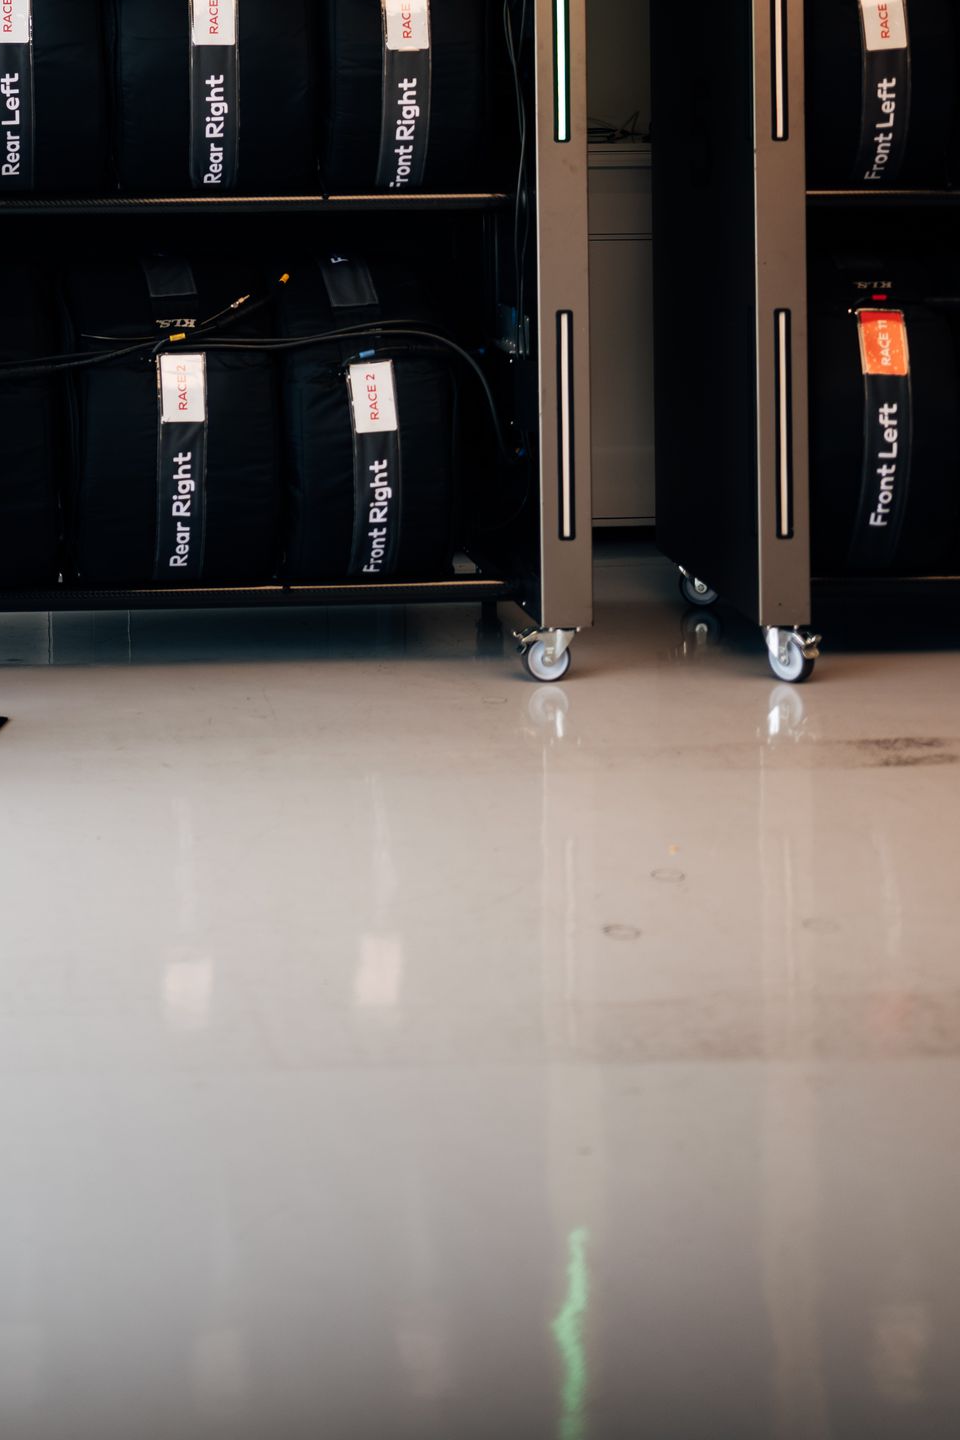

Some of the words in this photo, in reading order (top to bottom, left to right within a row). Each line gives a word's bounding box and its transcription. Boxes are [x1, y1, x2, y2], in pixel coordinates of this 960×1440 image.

[208, 3, 219, 35] RACE
[401, 8, 413, 39] RACE
[878, 3, 890, 39] RACE
[0, 72, 21, 126] Left
[205, 74, 229, 139] Right
[395, 77, 421, 141] Right
[875, 76, 897, 129] Left
[0, 130, 21, 176] Rear
[203, 142, 224, 184] Rear
[863, 131, 894, 180] Front
[877, 332, 892, 366] RACE
[177, 376, 189, 411] RACE
[368, 384, 380, 421] RACE
[878, 401, 898, 459] Left
[171, 451, 196, 517] Right
[368, 458, 393, 523] Right
[868, 463, 897, 527] Front
[168, 521, 190, 567] Rear
[362, 526, 388, 573] Front
